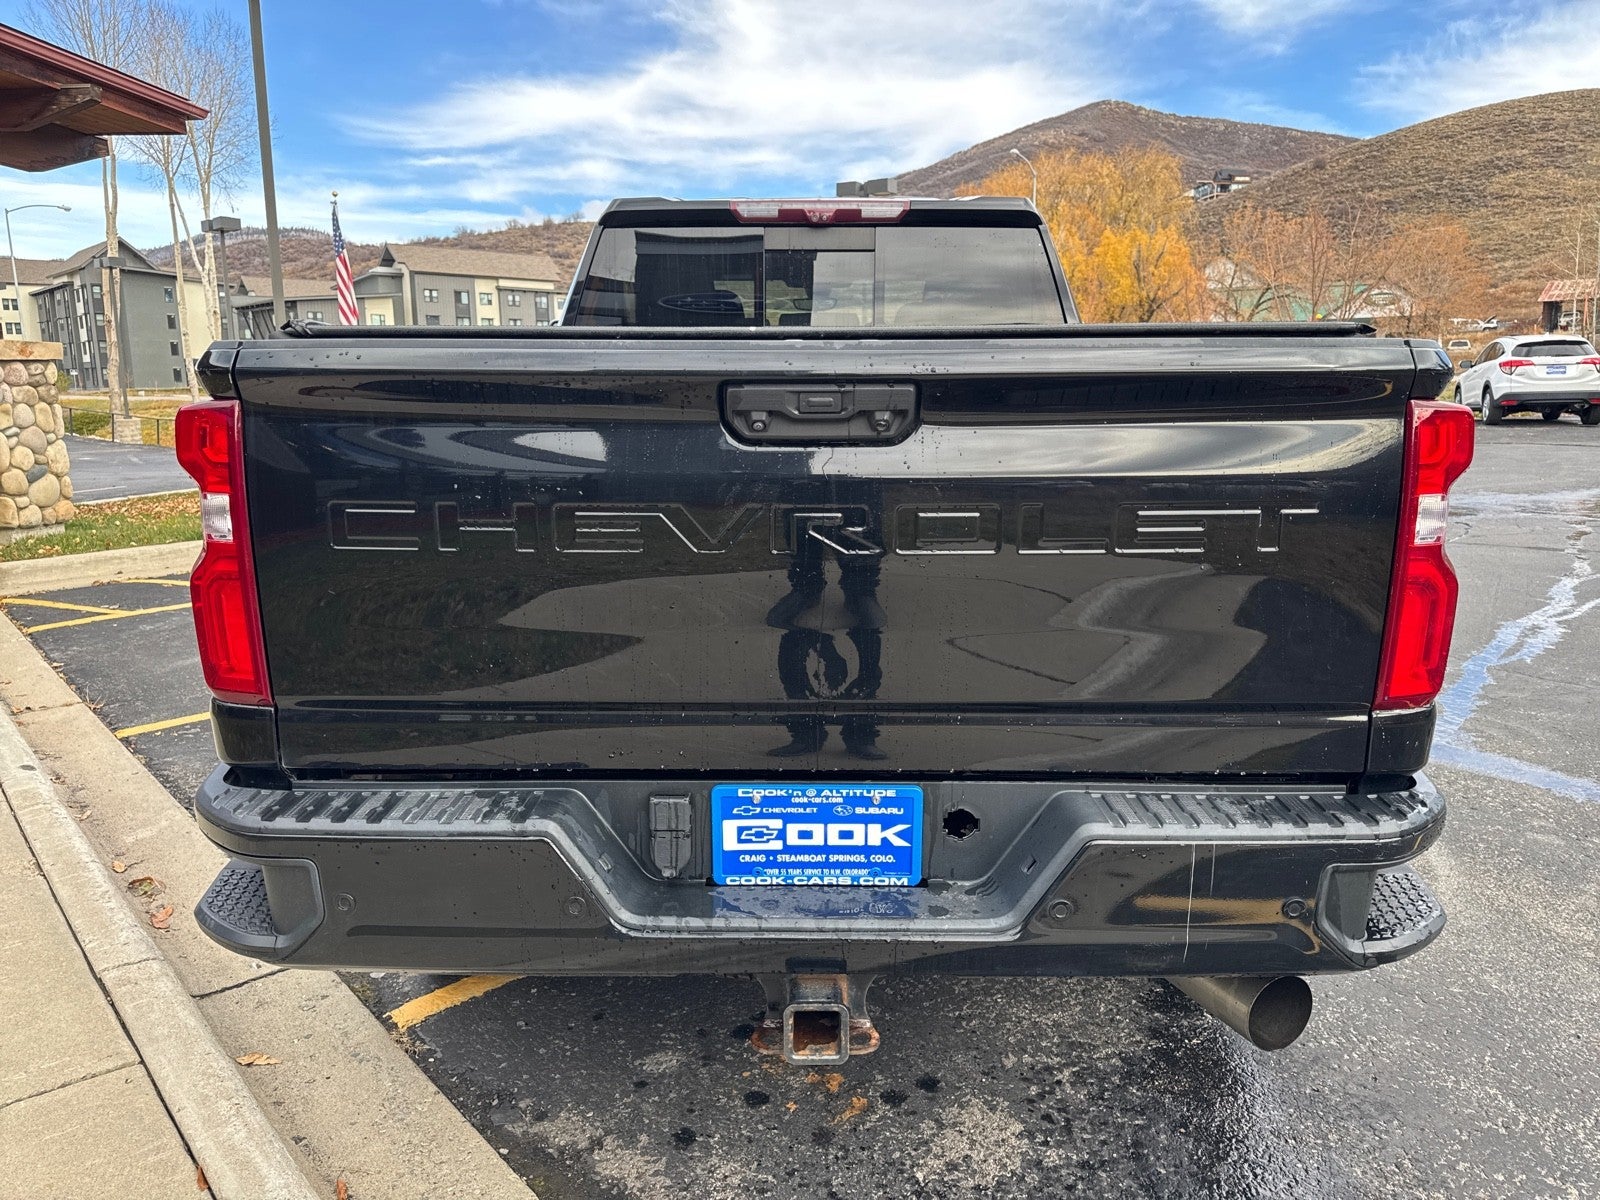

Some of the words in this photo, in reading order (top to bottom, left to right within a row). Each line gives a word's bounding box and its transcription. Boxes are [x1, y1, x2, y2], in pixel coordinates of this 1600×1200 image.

[328, 500, 1320, 555] CHEVROLET
[821, 789, 897, 797] ALTITUDE
[791, 796, 844, 804] cook-cars.com
[854, 807, 904, 815] SUBARU
[722, 818, 912, 851] COOK
[739, 854, 767, 863] CRAIG
[776, 854, 826, 863] STEAMBOAT
[828, 854, 868, 864] SPRINGS,
[870, 854, 896, 863] COLO.
[780, 868, 787, 876] 55
[787, 868, 803, 876] YEARS
[803, 868, 822, 876] SERVICE
[823, 868, 830, 876] TO
[725, 876, 909, 886] COOK-CARS.COM
